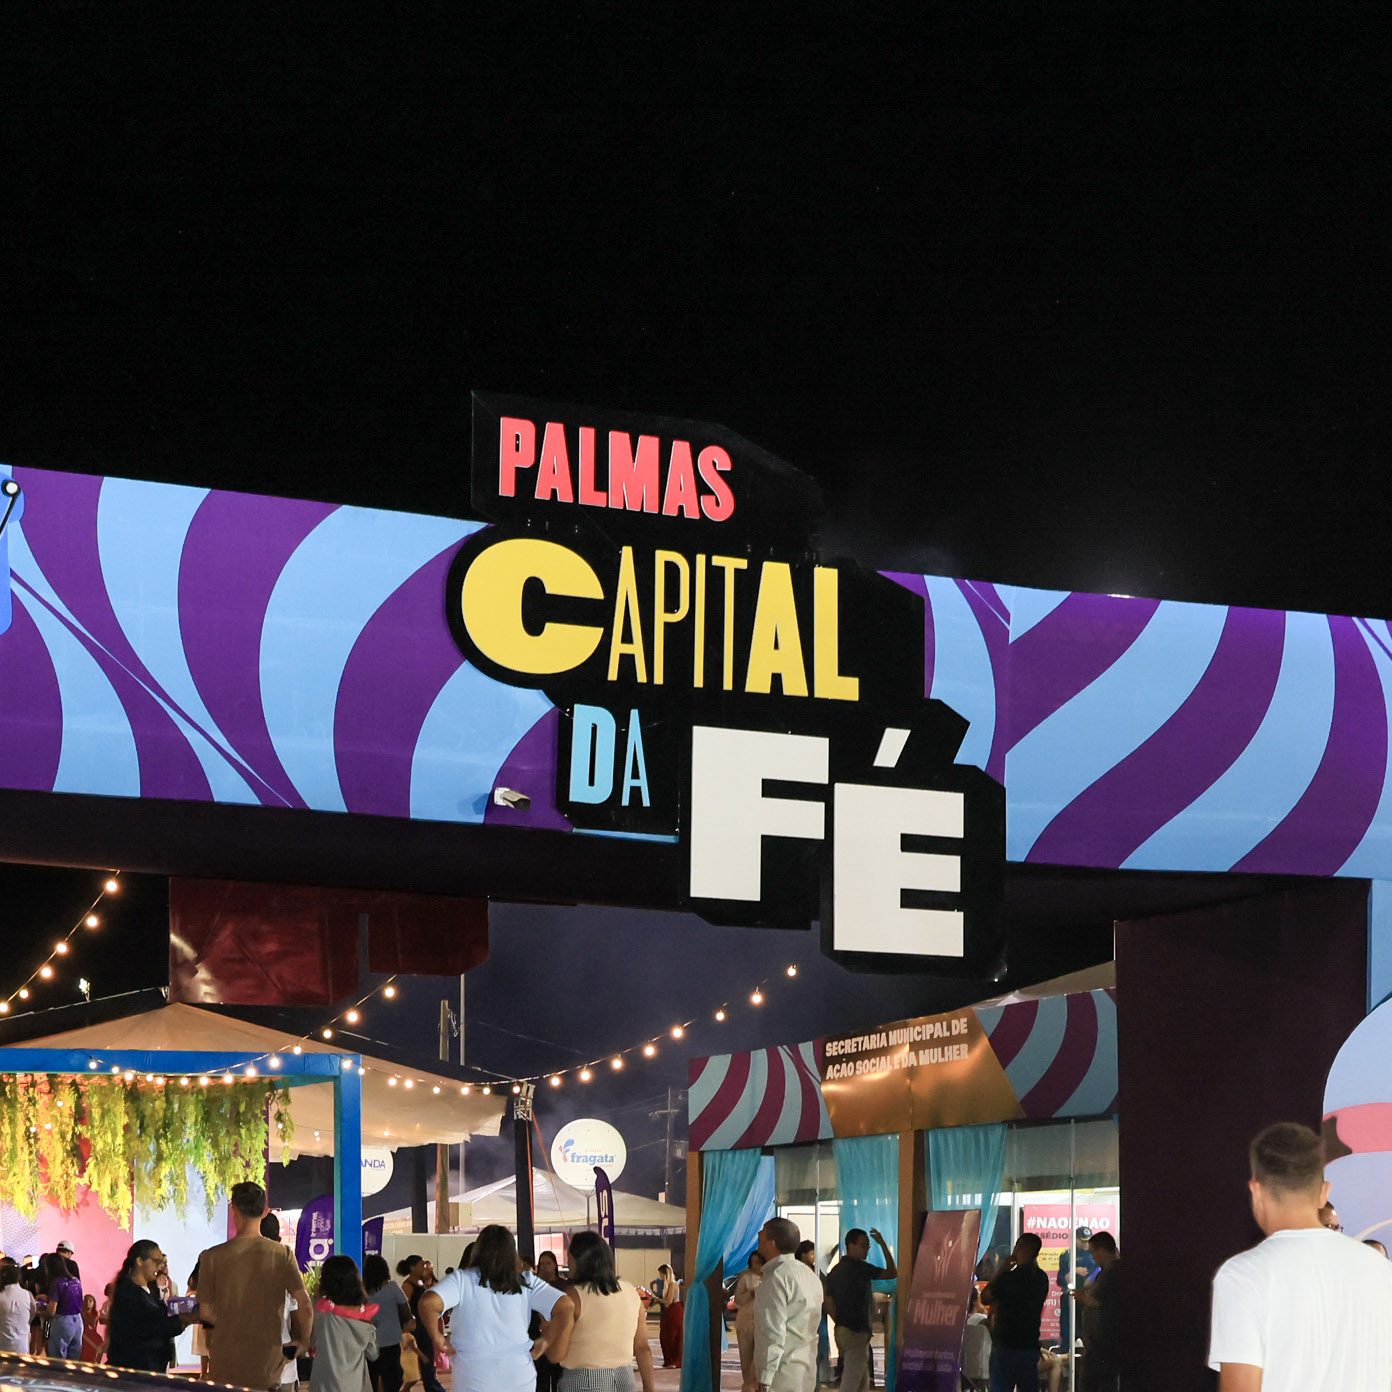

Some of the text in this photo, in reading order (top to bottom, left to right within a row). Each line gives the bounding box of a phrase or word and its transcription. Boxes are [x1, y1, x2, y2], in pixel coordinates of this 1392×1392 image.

[498, 416, 735, 522] PALMAS
[461, 538, 860, 702] CAPITAL
[568, 704, 965, 958] DA FÉ
[825, 1017, 969, 1057] SECRETARIA MUNICIPAL DE
[856, 1058, 892, 1076] SOCIAL
[893, 1055, 901, 1071] E
[901, 1053, 918, 1069] DA
[919, 1043, 969, 1066] MULHER
[570, 1152, 615, 1166] fragata
